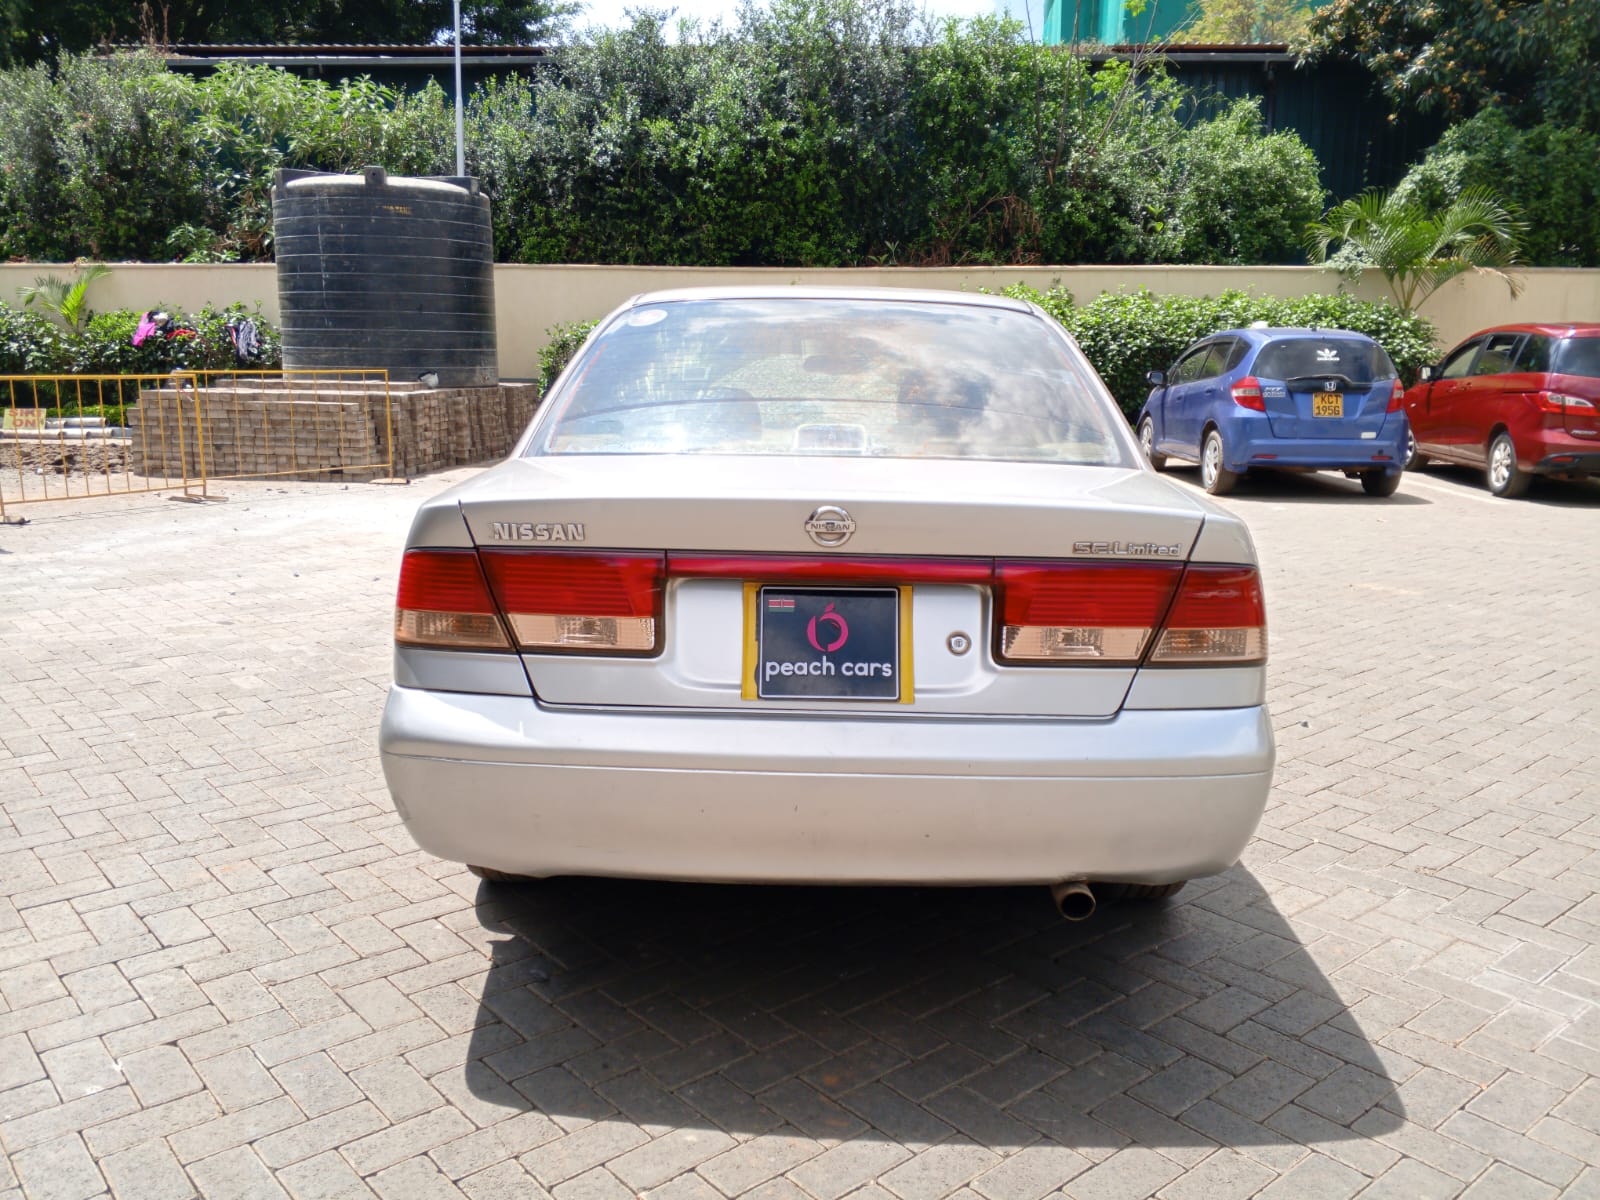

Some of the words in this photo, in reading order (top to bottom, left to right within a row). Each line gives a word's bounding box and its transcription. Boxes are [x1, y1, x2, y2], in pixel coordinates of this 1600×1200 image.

[1320, 393, 1342, 405] KCT
[1315, 405, 1341, 416] 195G
[493, 522, 585, 541] NISSAN
[765, 655, 835, 682] peach
[841, 661, 893, 677] cars
